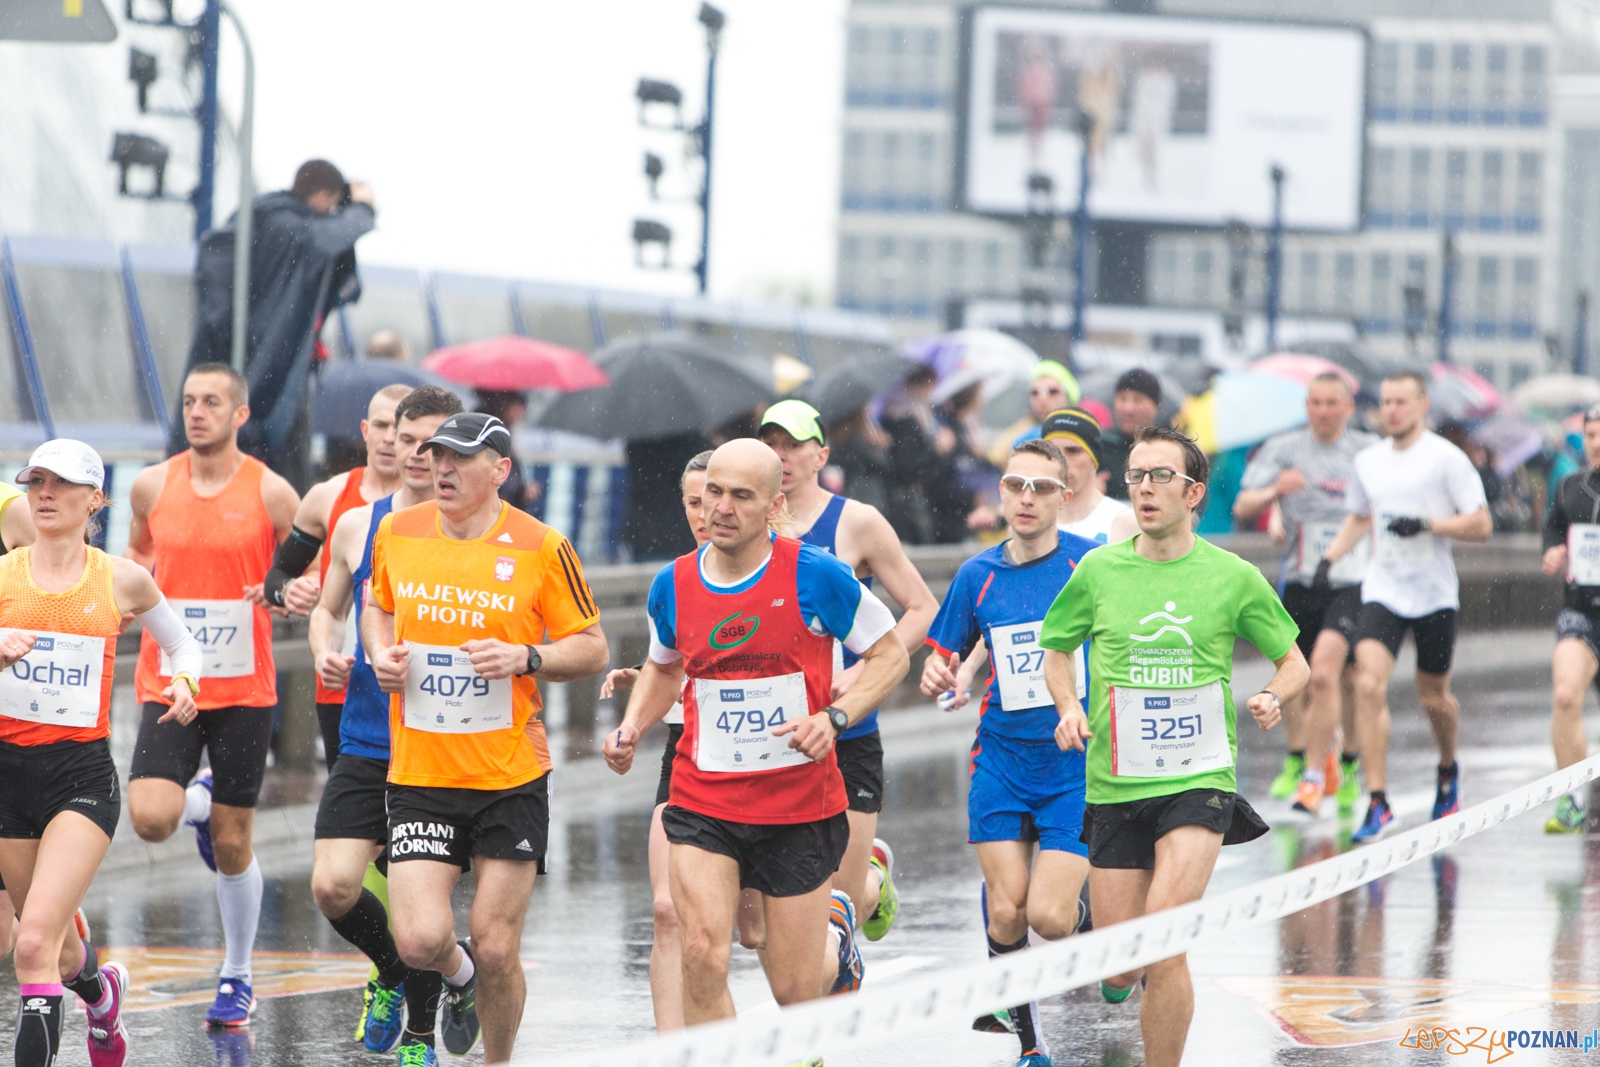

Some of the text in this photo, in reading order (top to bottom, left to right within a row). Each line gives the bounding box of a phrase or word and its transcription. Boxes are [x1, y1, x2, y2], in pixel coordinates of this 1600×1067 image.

[397, 581, 515, 613] MAJEWSKI
[417, 604, 486, 629] PIOTR
[186, 626, 237, 645] 477
[720, 625, 746, 638] SGB
[692, 652, 782, 668] Bank Spółdzielczy
[718, 663, 765, 673] Dobrzycy
[1006, 650, 1045, 675] 127
[1129, 656, 1193, 666] BiegamBoLubie
[12, 658, 90, 687] Ochal
[1129, 666, 1193, 685] GUBIN
[42, 687, 60, 696] Olga
[420, 674, 489, 697] 4079
[716, 706, 787, 734] 4794
[1141, 714, 1202, 740] 3251
[733, 735, 769, 744] Sławomir
[1151, 741, 1196, 750] Przemysław
[391, 821, 455, 842] BRYLANT
[391, 837, 451, 858] KÓRNIK
